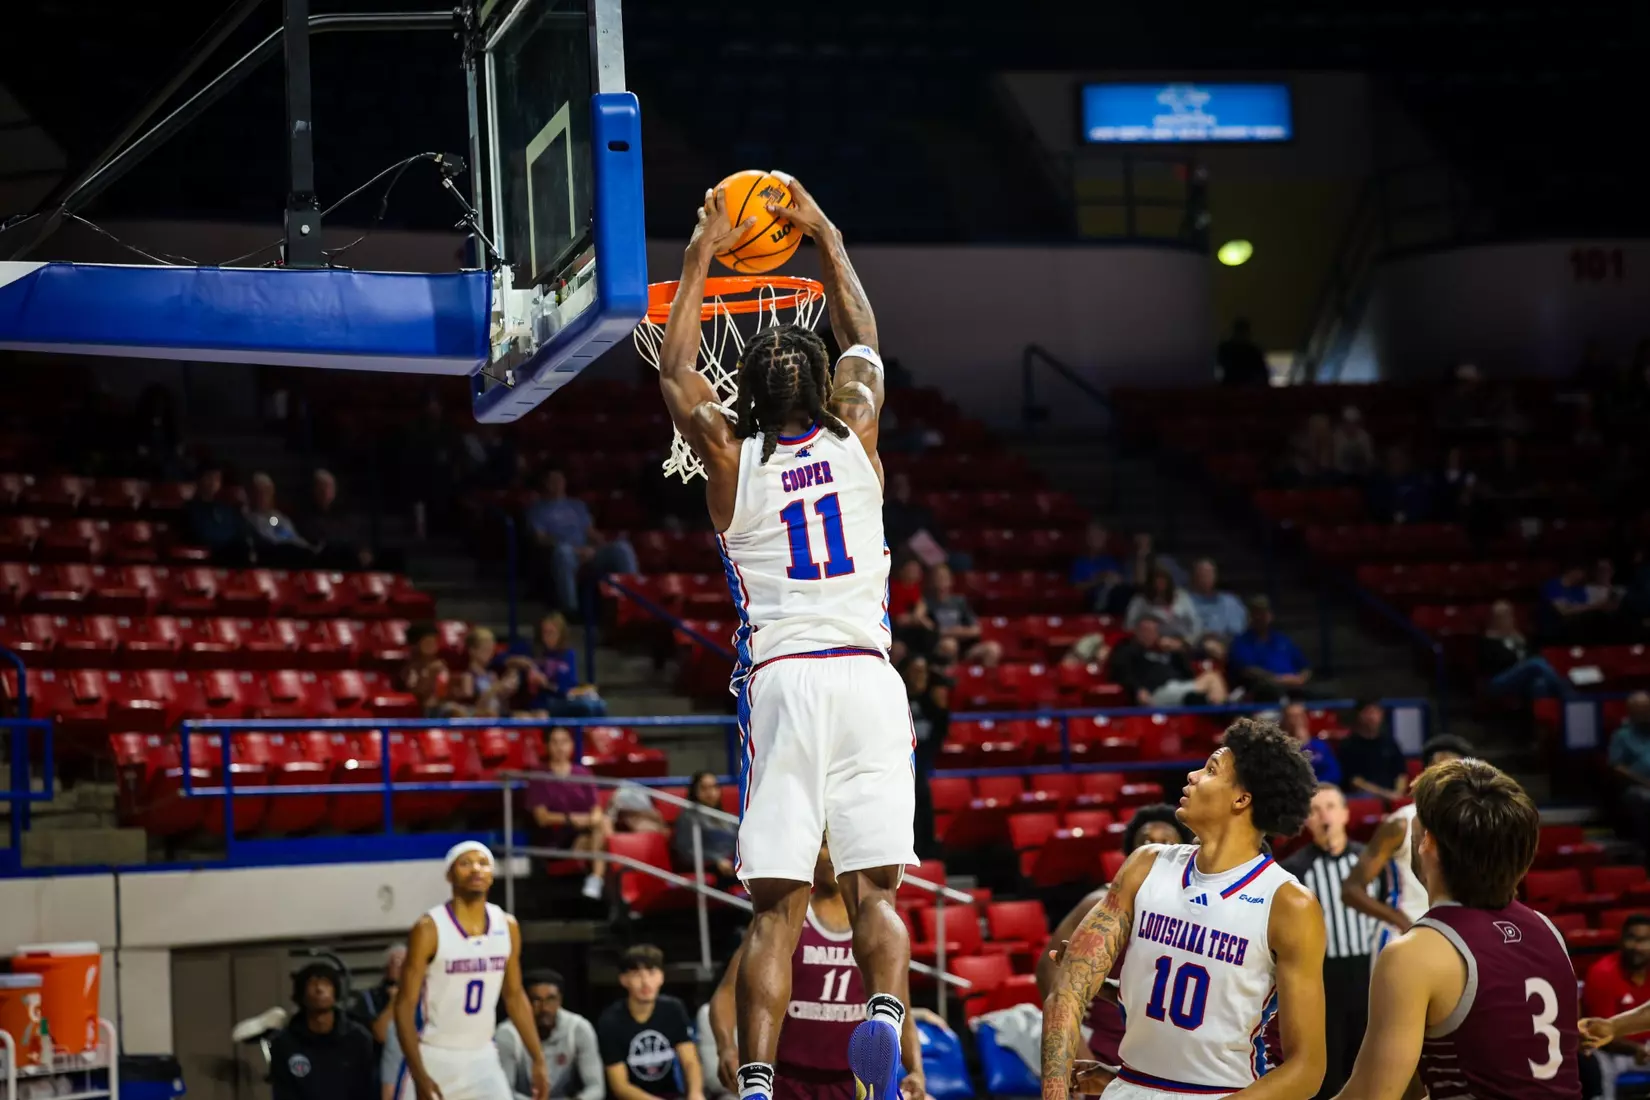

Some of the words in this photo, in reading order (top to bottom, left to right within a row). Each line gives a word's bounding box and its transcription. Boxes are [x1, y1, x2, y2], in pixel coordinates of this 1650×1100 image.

[1569, 247, 1623, 280] 101
[781, 461, 833, 493] COOPER
[779, 492, 855, 580] 11
[803, 945, 857, 967] DALLA
[1138, 910, 1207, 955] LOUISIANA
[1207, 929, 1249, 966] TECH
[464, 979, 484, 1015] 0
[820, 969, 852, 1002] 11
[1145, 955, 1211, 1031] 10
[1525, 977, 1563, 1080] 3
